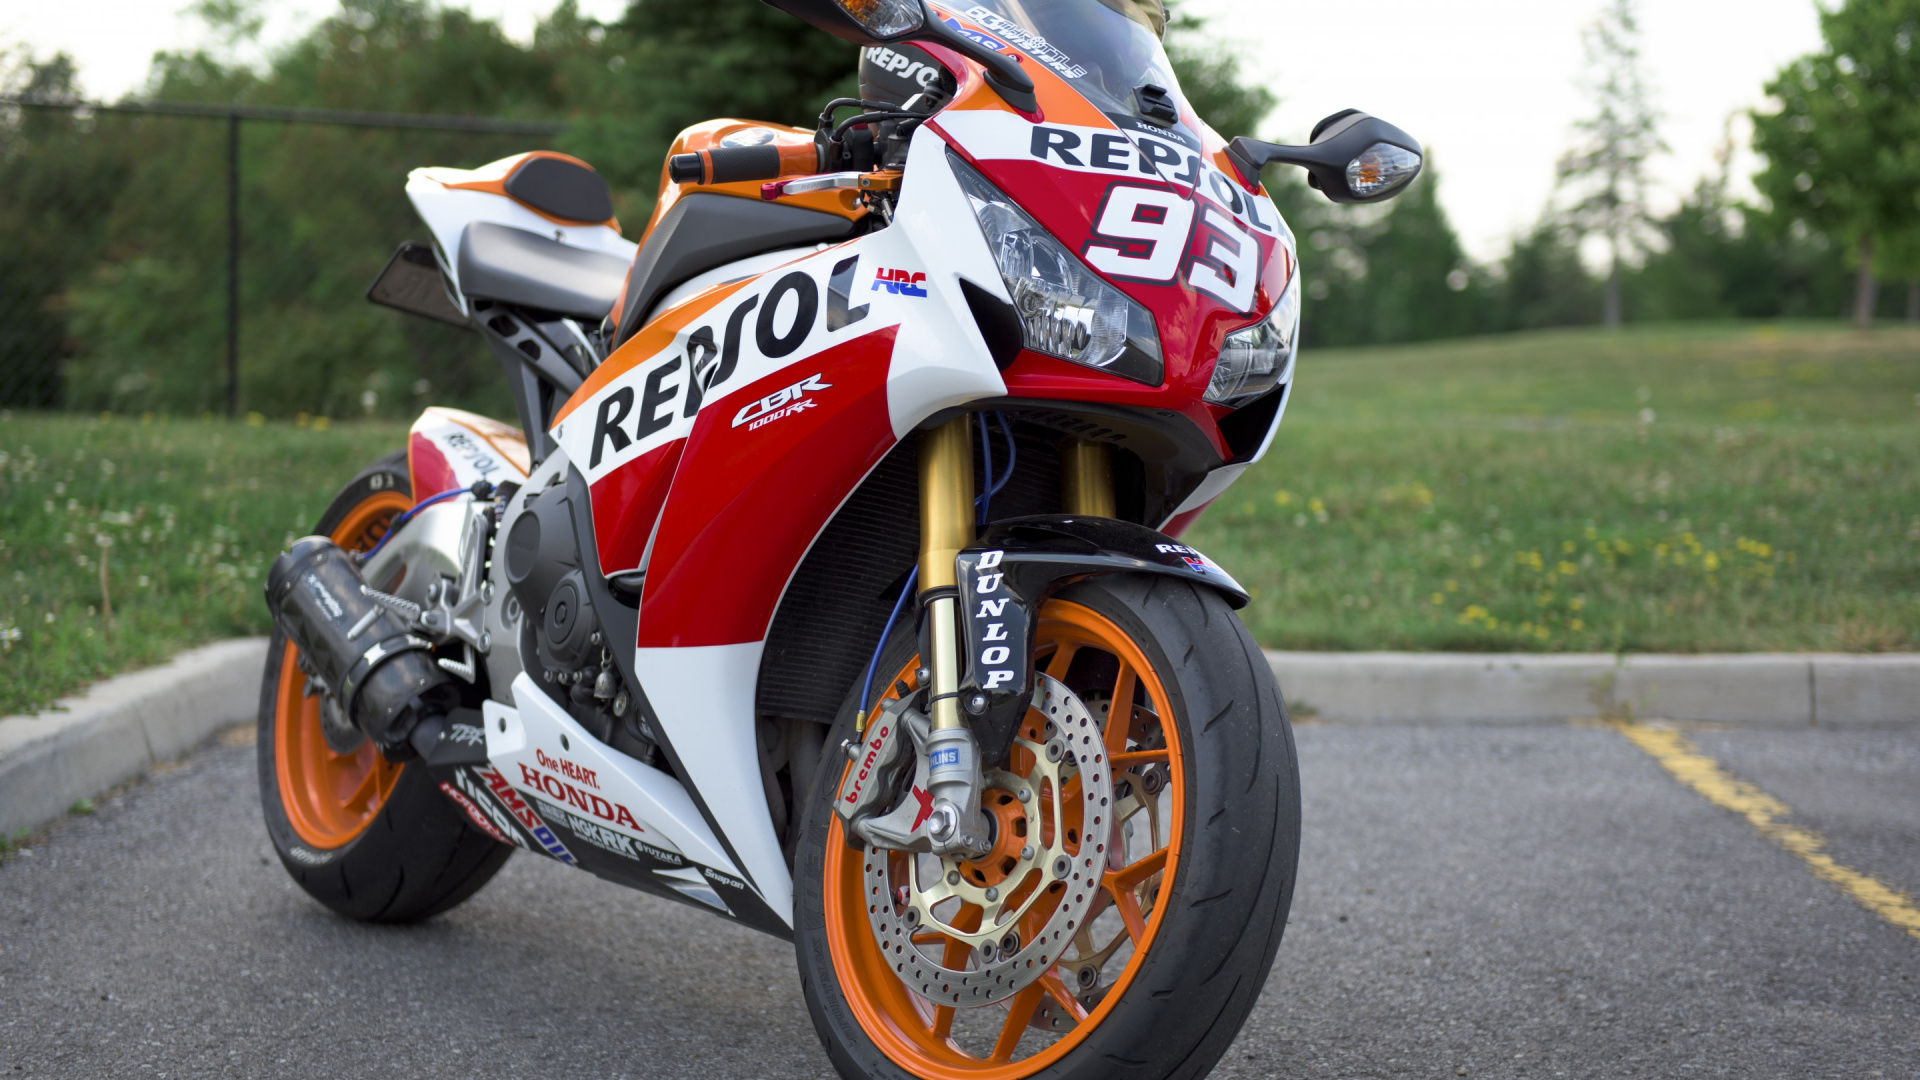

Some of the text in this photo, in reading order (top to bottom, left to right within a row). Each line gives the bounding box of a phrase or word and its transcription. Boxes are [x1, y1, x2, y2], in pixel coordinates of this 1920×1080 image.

[866, 46, 939, 89] REPSO
[1135, 121, 1187, 144] HONDA
[1030, 125, 1272, 232] REPSOL
[1081, 182, 1262, 317] 93
[871, 267, 928, 298] HRC
[589, 253, 871, 471] REPSOL
[731, 372, 833, 429] CBR
[446, 432, 500, 476] REPSOL
[975, 550, 1014, 689] DUNLOP
[536, 748, 559, 773] One
[844, 725, 888, 804] brembo
[930, 751, 957, 766] HLINS
[477, 763, 577, 868] AMSOIL
[518, 761, 645, 833] HONDA
[704, 867, 744, 890] Snap-on
